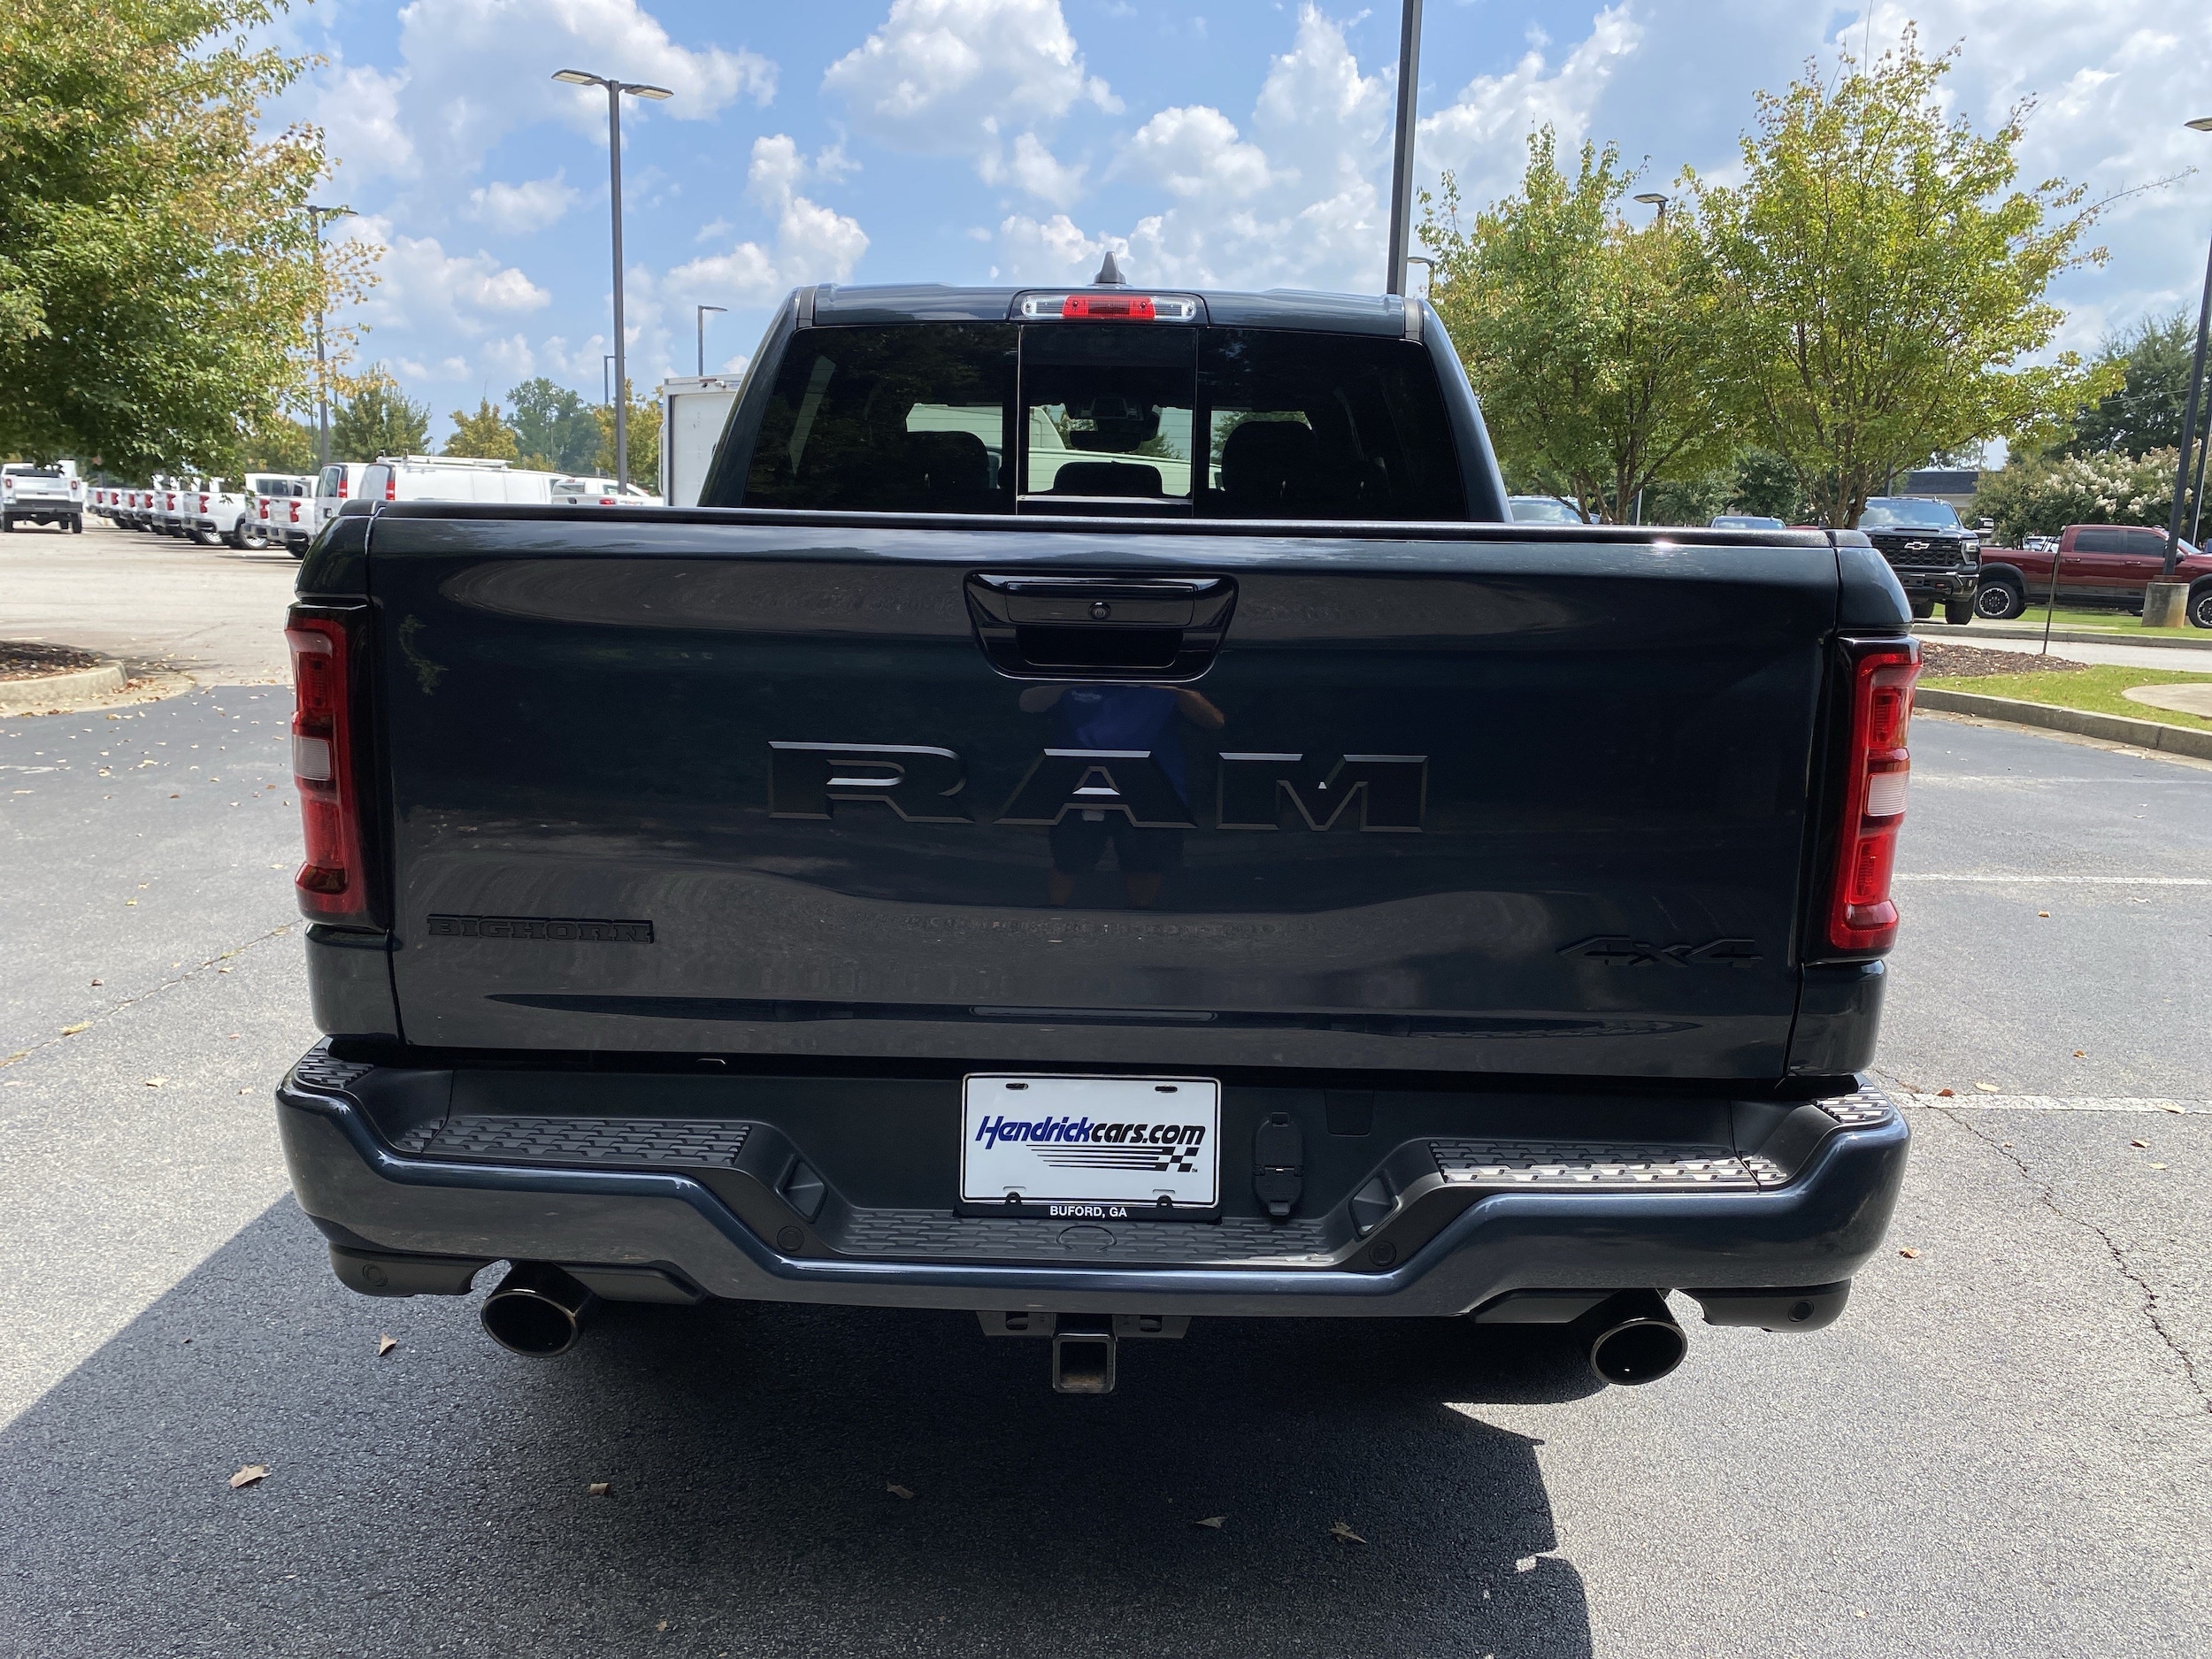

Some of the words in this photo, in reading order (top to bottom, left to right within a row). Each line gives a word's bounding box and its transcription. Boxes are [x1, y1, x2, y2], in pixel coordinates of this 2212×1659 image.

[768, 741, 1428, 831] RAM
[974, 1115, 1206, 1149] Hendrickcars.com
[1049, 1205, 1106, 1219] BUFORD,
[1109, 1207, 1128, 1218] GA
